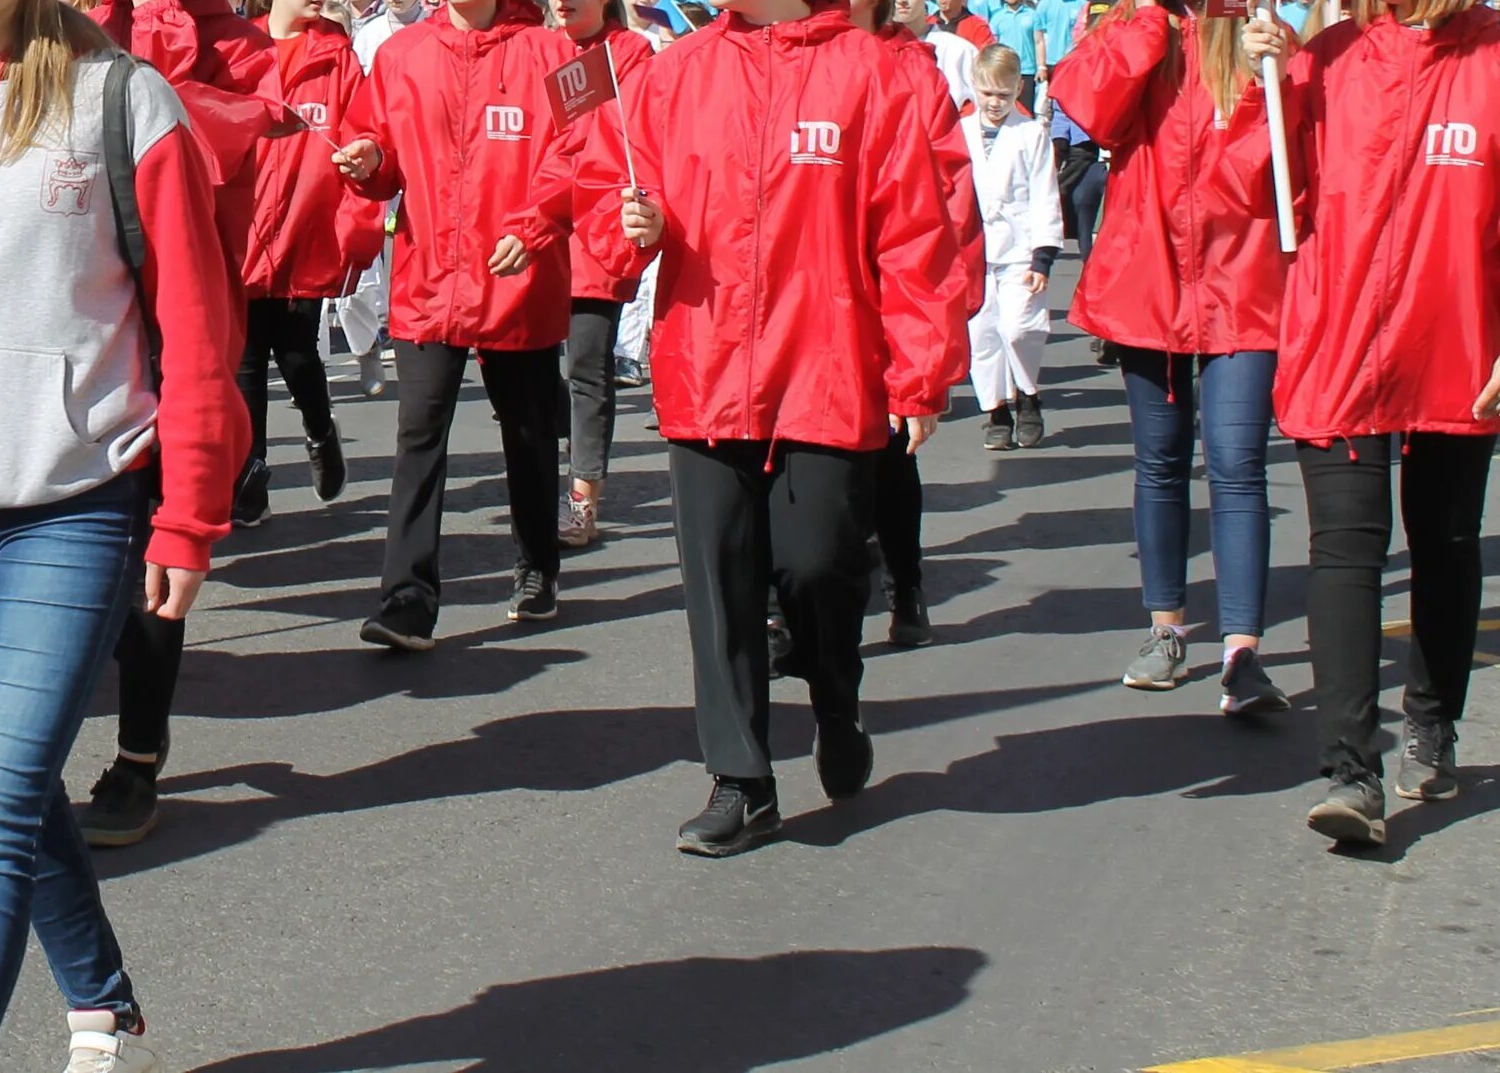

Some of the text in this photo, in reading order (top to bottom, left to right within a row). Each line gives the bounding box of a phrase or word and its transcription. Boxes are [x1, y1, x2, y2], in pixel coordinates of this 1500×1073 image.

[556, 60, 587, 103] ГТО
[485, 105, 524, 133] ГТО
[790, 121, 841, 155] ГТО
[1426, 122, 1477, 155] ГТО
